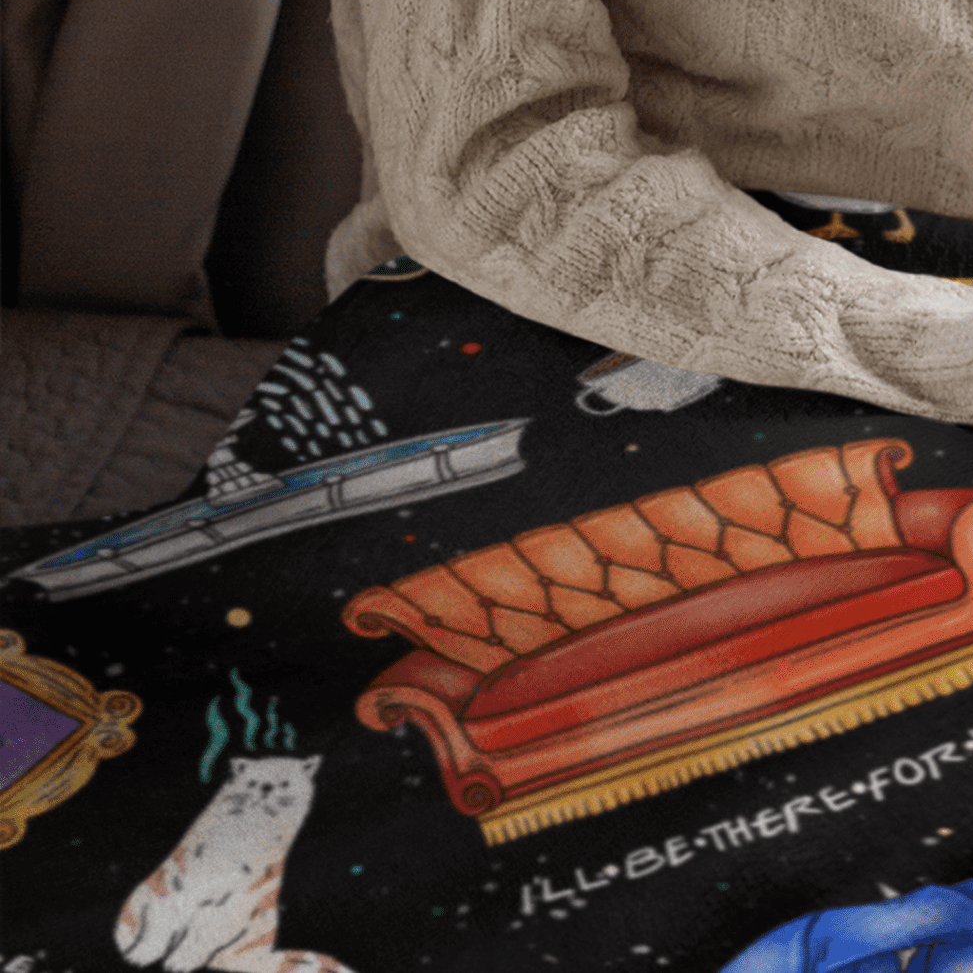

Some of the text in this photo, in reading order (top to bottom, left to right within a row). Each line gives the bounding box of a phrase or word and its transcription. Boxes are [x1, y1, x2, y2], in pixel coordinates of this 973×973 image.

[624, 835, 694, 880] BE
[701, 786, 855, 851] THERE
[868, 741, 965, 801] FOR
